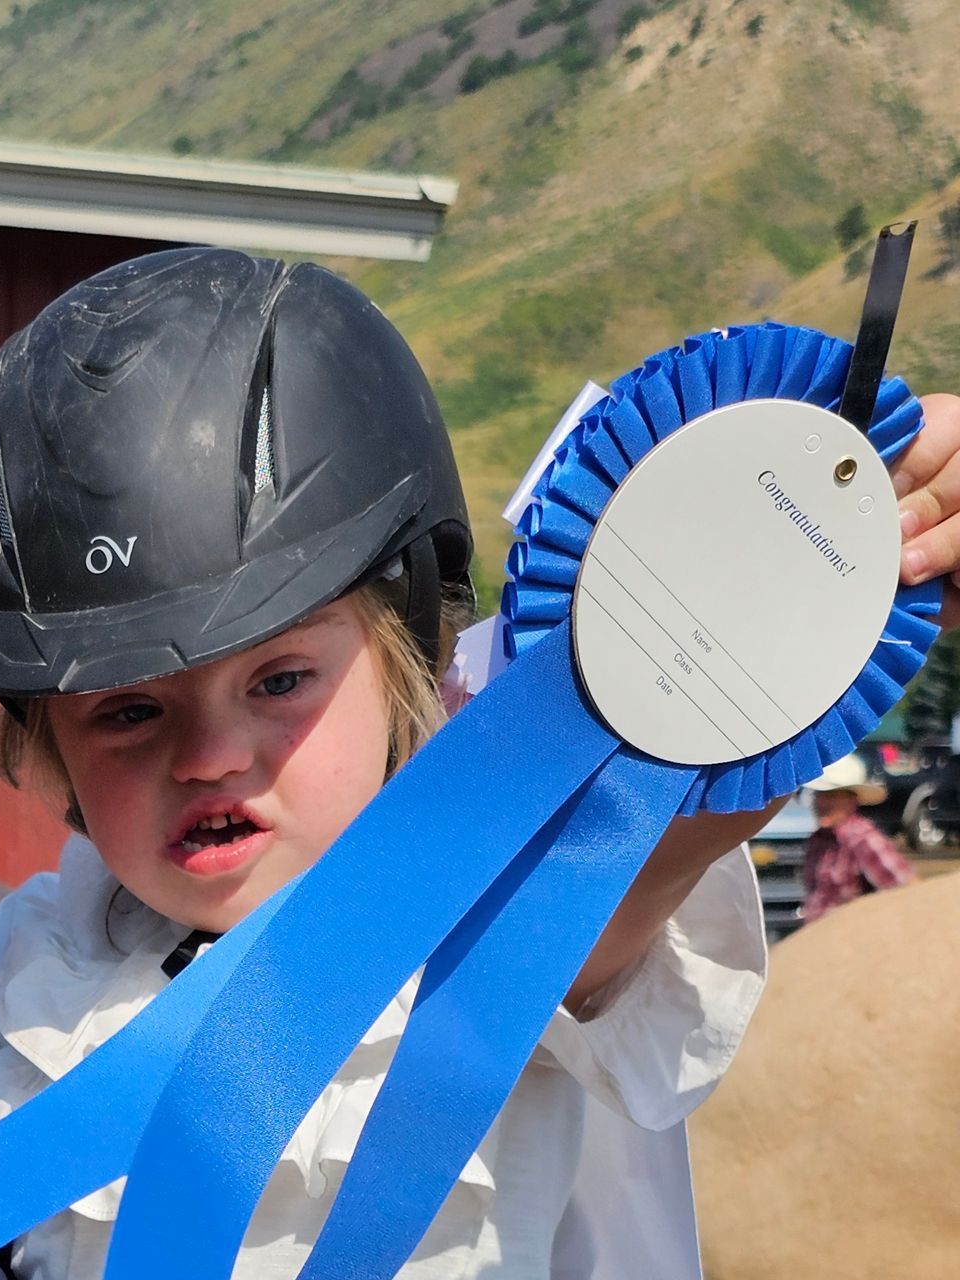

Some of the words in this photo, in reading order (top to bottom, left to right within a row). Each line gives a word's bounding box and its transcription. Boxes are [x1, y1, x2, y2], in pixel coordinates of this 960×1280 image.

[757, 469, 856, 578] Congratulations!
[691, 628, 713, 654] Name
[673, 652, 693, 676] Class
[655, 675, 673, 697] Date
